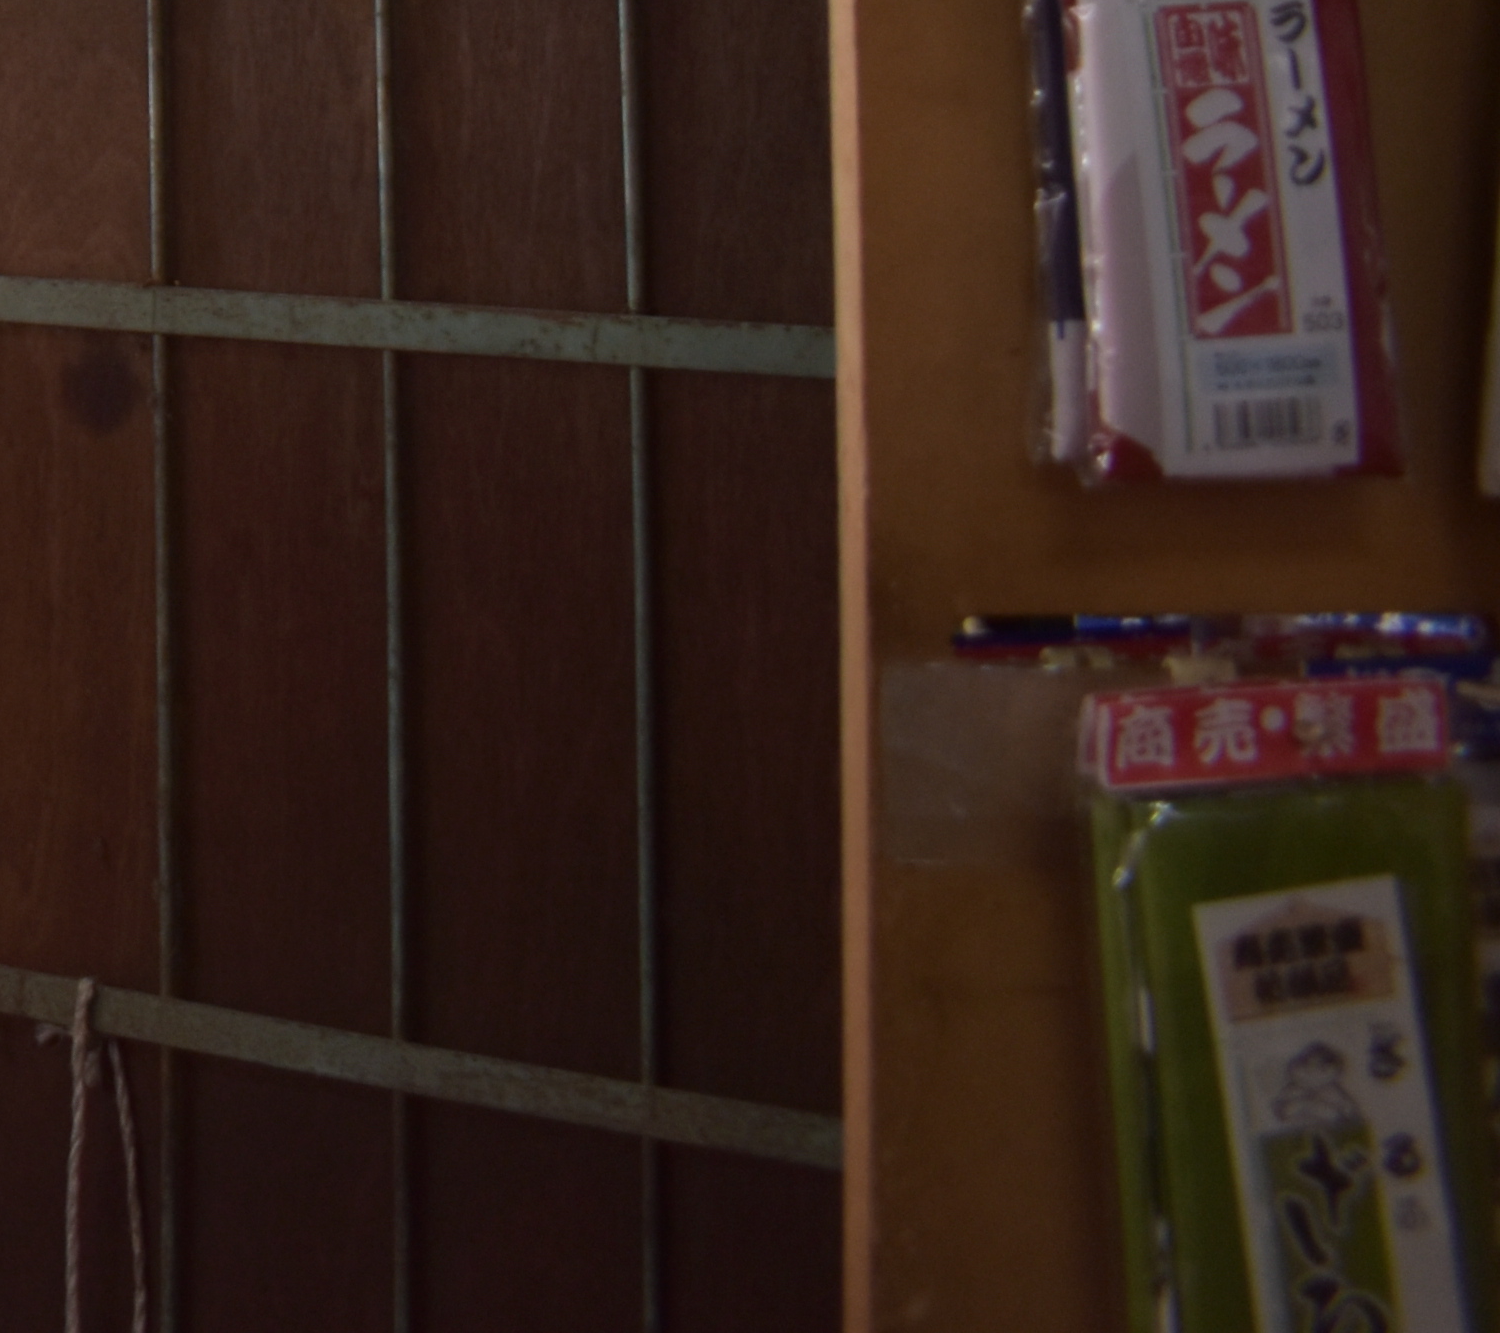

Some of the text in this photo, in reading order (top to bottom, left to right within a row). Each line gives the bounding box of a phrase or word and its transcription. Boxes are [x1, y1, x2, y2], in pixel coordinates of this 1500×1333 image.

[1271, 0, 1326, 186] ラーメン
[1182, 87, 1279, 334] ラーメン
